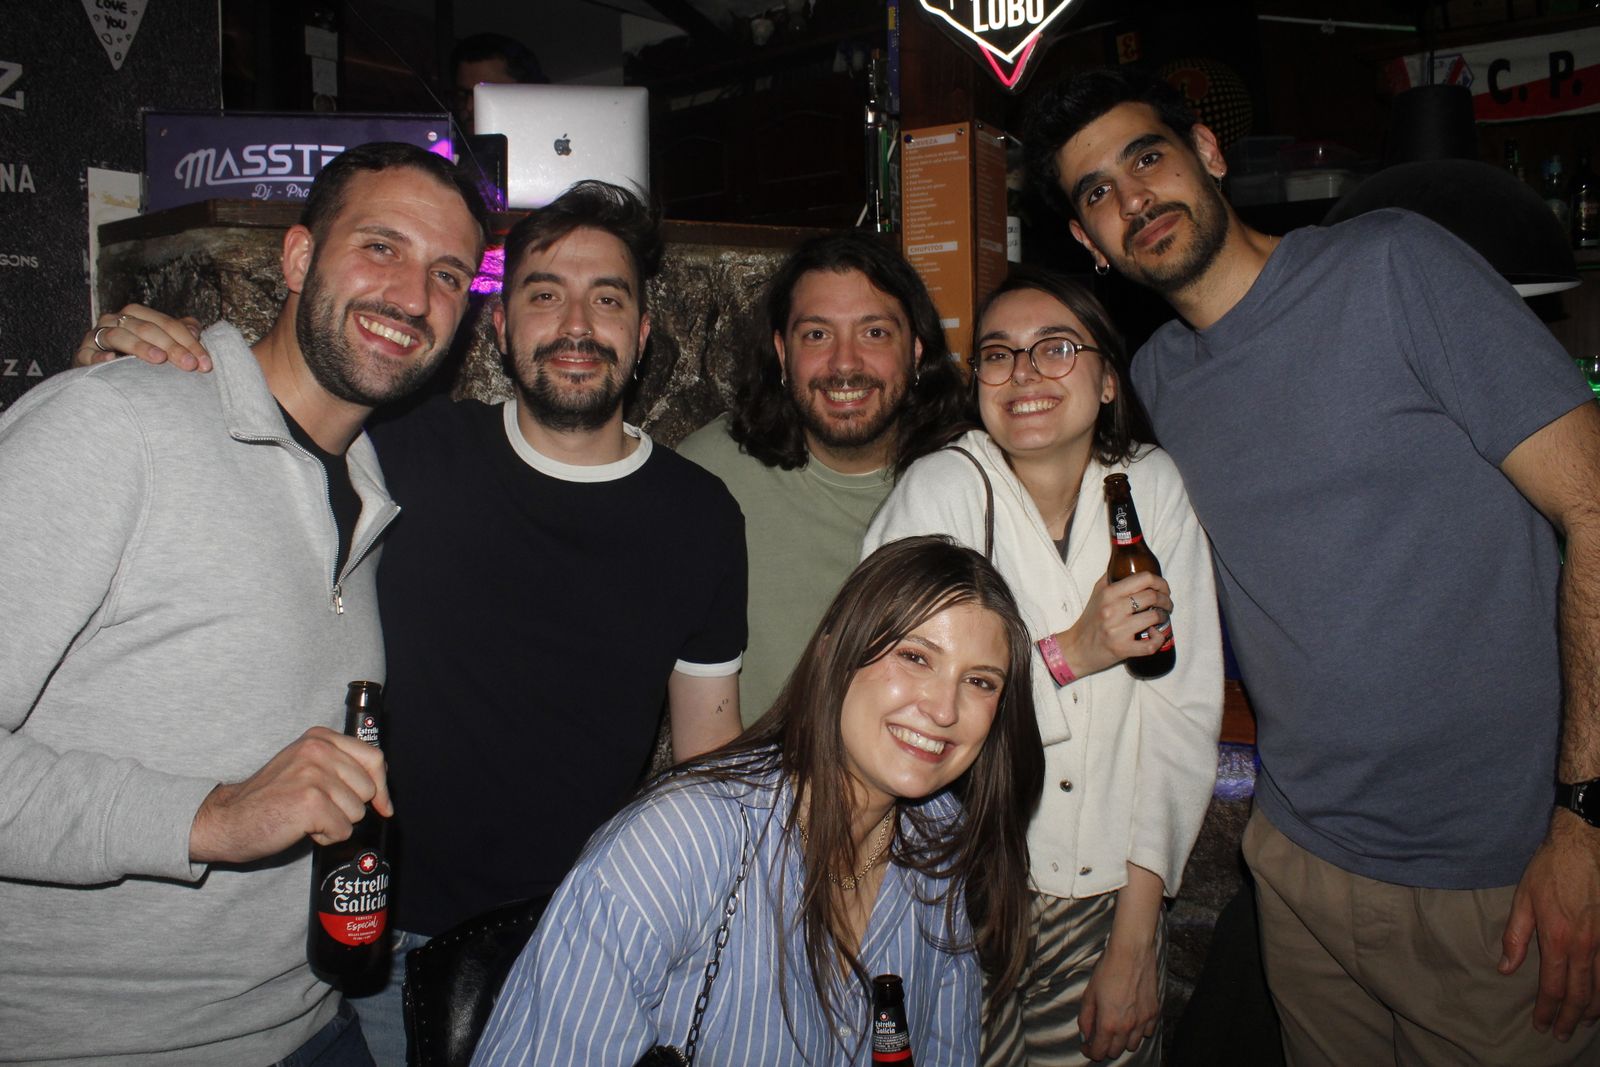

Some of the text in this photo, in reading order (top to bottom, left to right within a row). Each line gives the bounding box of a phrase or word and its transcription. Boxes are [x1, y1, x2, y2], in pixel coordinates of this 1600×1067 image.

[96, 0, 128, 14] LOVE
[973, 0, 1044, 33] LOBO
[104, 15, 127, 30] YOU
[0, 163, 36, 193] NA
[251, 183, 272, 200] Dj
[332, 873, 389, 895] Estrella
[333, 892, 386, 913] Galicia
[346, 915, 379, 932] Especial
